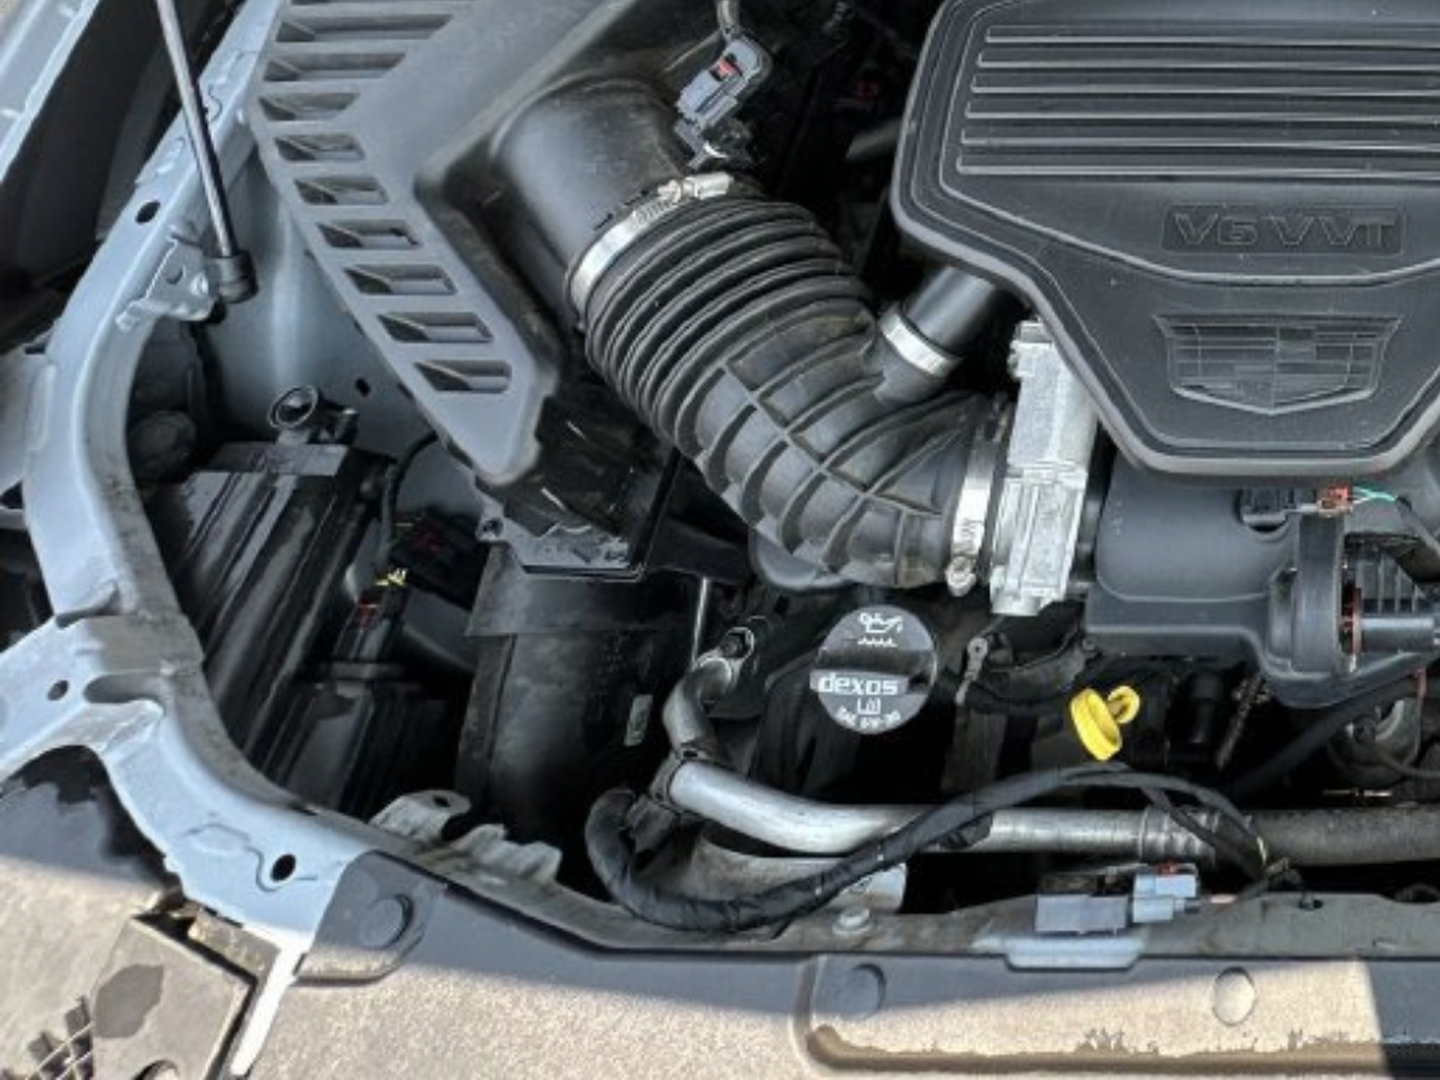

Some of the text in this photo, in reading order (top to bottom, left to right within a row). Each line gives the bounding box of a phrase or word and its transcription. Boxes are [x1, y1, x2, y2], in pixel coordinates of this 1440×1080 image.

[1173, 213, 1396, 246] V6 VVT
[818, 672, 898, 695] dexos
